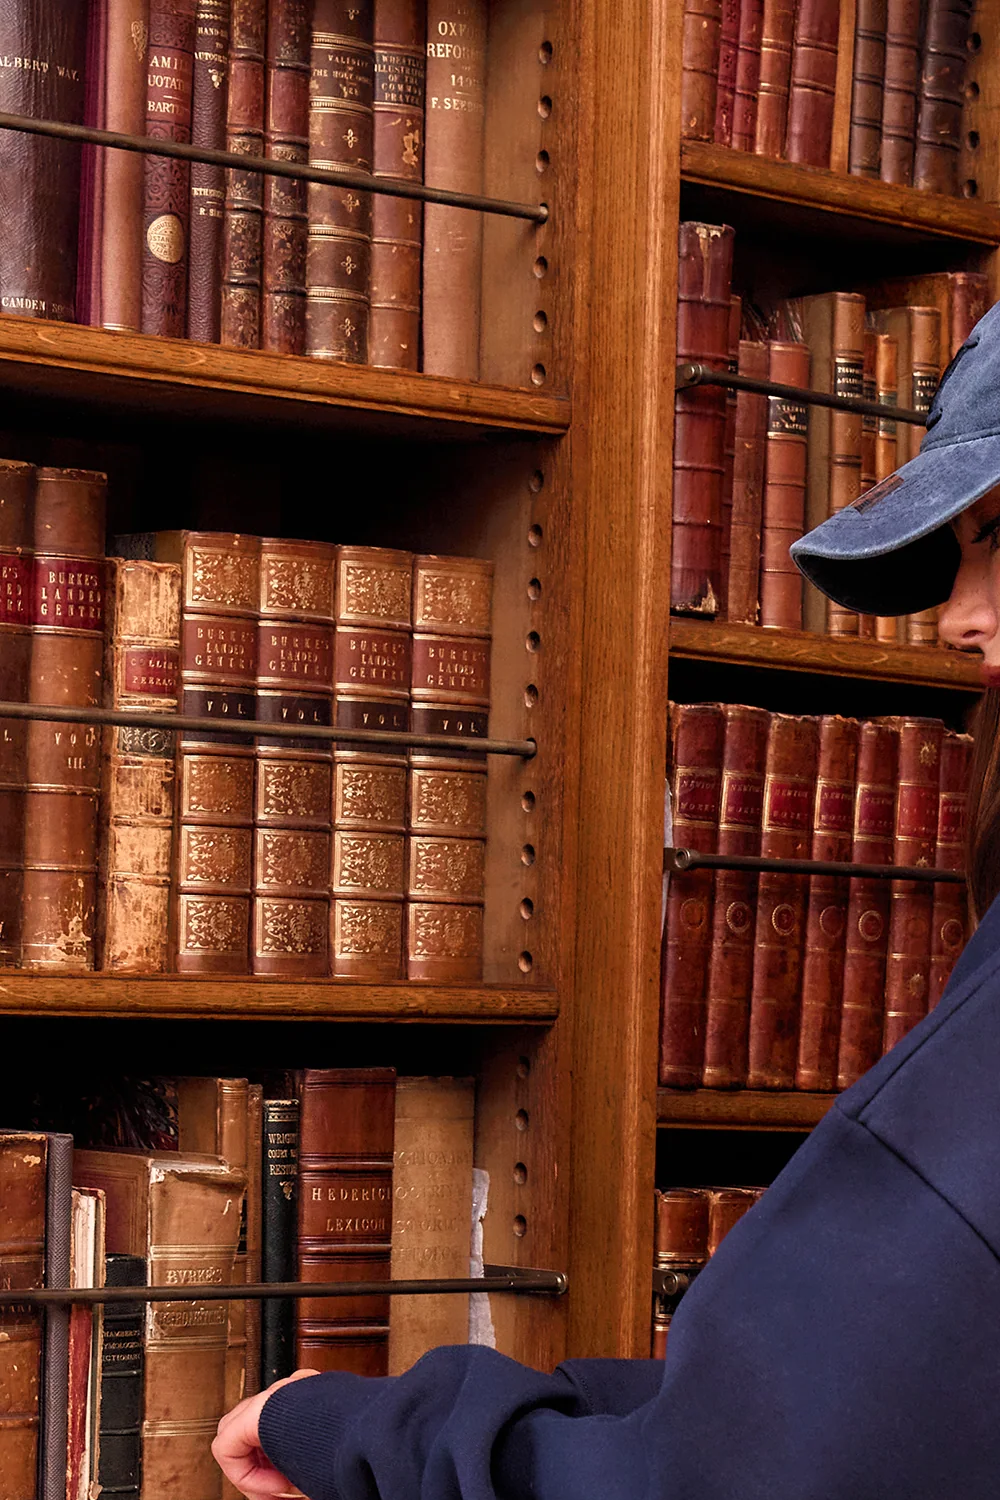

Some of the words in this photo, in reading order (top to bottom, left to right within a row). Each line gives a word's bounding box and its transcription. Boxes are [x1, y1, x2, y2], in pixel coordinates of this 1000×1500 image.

[2, 296, 46, 311] CAMDEN
[48, 571, 98, 587] BURKE'S
[197, 627, 254, 644] BURKE'S
[271, 635, 329, 650] BURKE'S
[207, 700, 247, 715] VOL.
[282, 707, 320, 723] VOL.
[363, 713, 400, 727] VOL.
[443, 720, 478, 734] VOL.
[67, 757, 86, 770] III.
